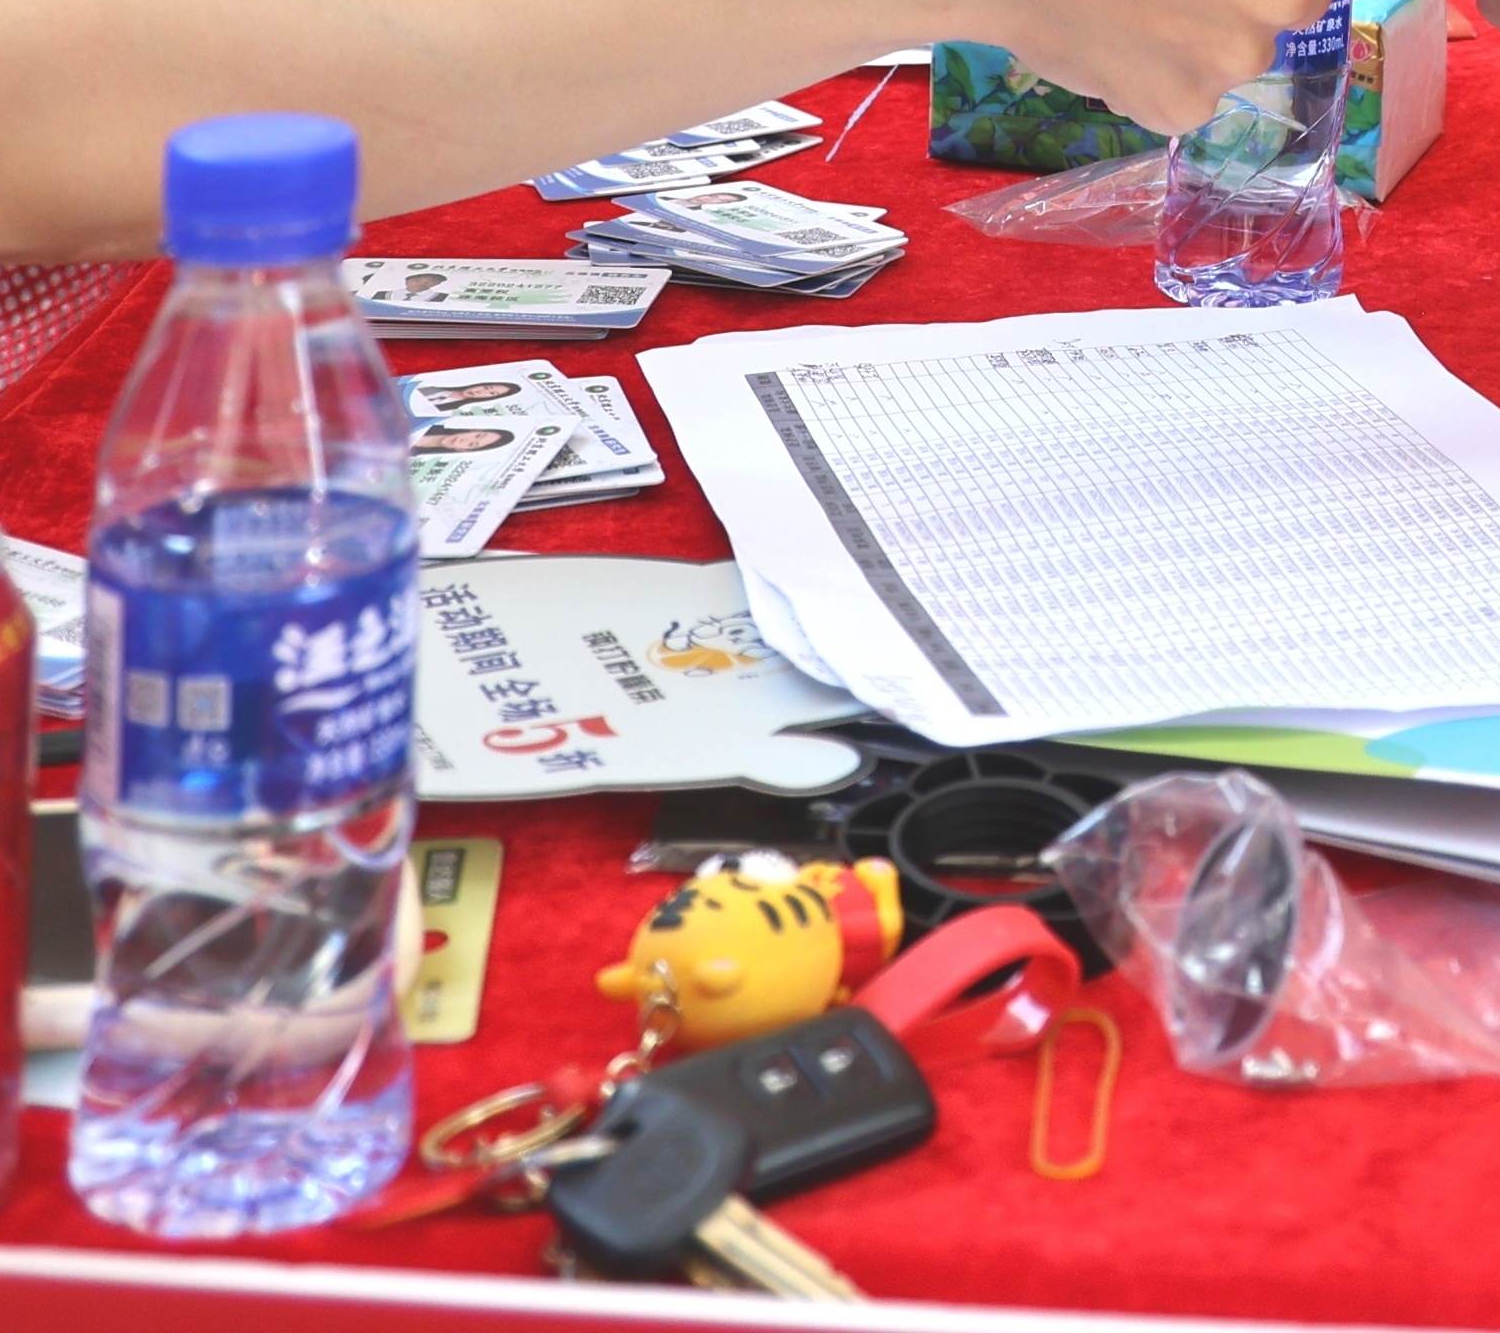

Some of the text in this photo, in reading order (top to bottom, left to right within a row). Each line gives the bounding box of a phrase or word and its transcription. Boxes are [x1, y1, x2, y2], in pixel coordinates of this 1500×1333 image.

[419, 582, 620, 773] 活动期间 全场5折
